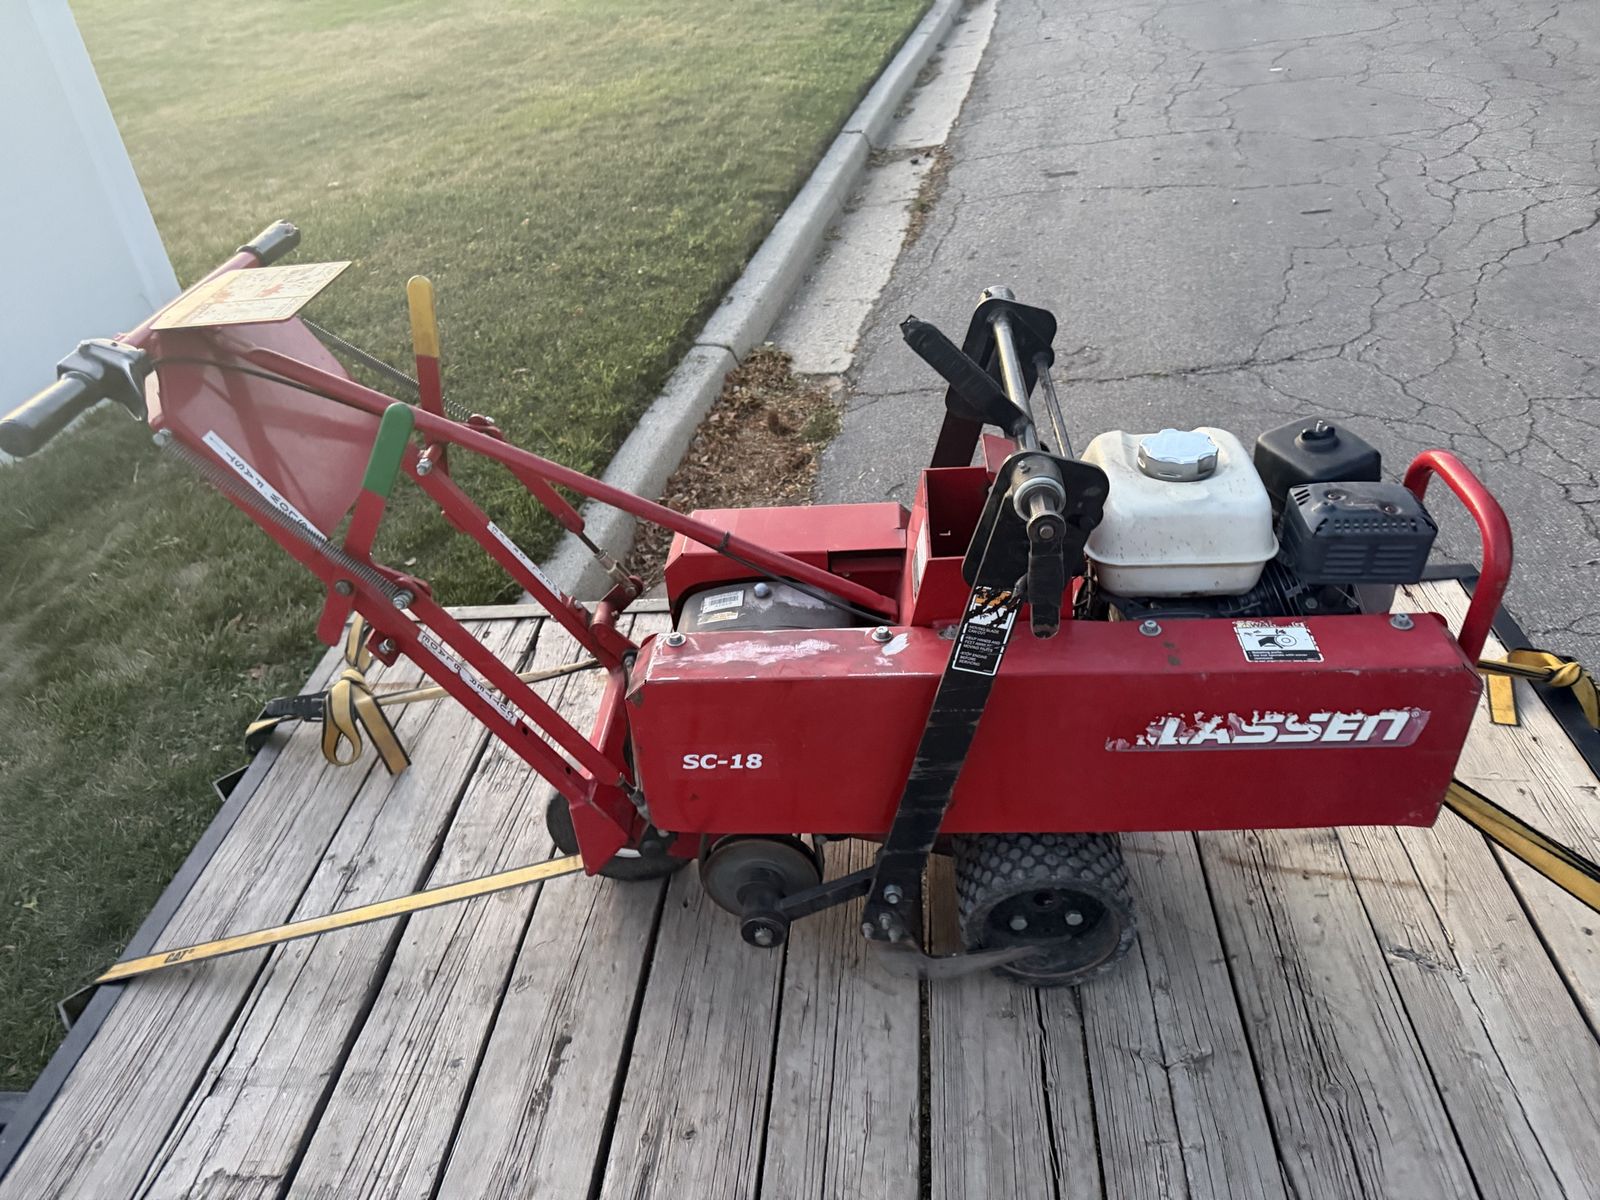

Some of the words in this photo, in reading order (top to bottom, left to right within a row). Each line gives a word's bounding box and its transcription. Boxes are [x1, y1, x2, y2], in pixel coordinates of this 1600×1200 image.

[226, 452, 265, 489] FAST
[422, 634, 462, 671] BLADE
[469, 679, 515, 720] CUTTER
[1136, 709, 1411, 746] LASSEN
[682, 753, 763, 770] SC-18
